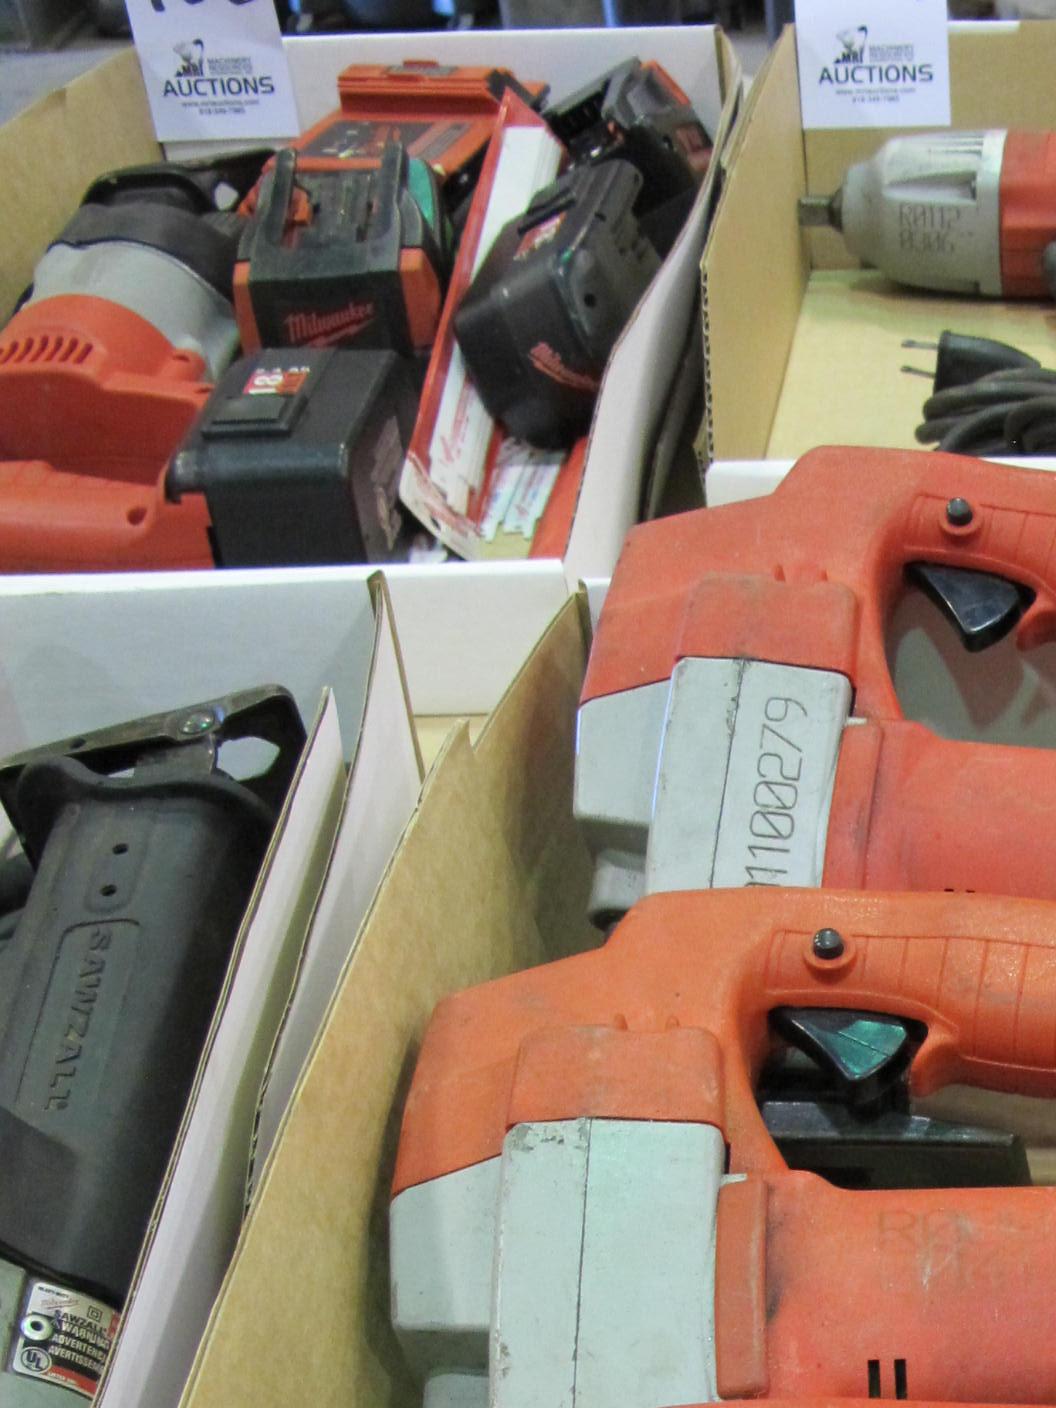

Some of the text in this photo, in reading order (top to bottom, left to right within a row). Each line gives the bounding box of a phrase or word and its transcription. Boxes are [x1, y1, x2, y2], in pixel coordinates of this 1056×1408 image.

[819, 64, 933, 85] AUCTIONS
[163, 76, 275, 97] AUCTIONS
[44, 928, 113, 1111] SAWZALL
